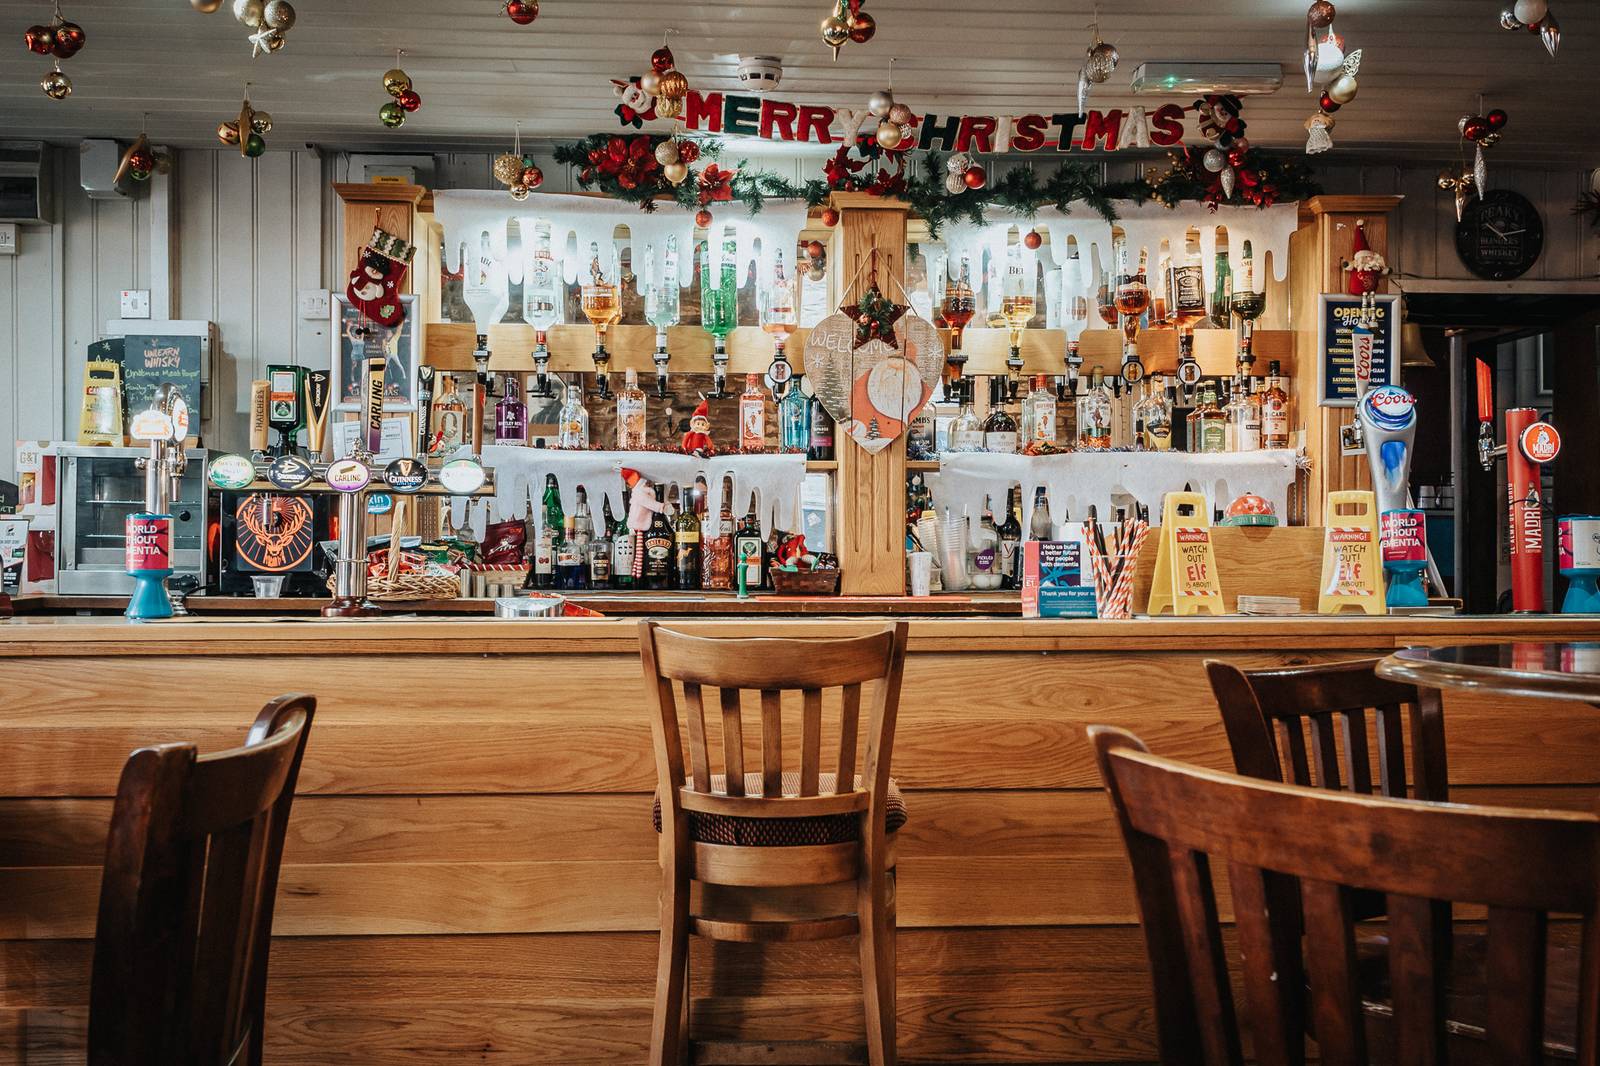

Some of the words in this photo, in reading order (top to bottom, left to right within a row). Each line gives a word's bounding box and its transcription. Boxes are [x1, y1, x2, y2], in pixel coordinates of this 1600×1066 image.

[686, 90, 869, 147] MERRY
[900, 104, 1185, 151] HRISTMAS
[144, 356, 180, 368] WHISKY
[1356, 337, 1370, 380] Coors
[369, 379, 383, 430] CARLING
[1372, 393, 1416, 407] Coors
[254, 390, 264, 433] THATCHERS
[334, 474, 361, 482] CARLING
[389, 475, 423, 483] GUINNESS
[1384, 518, 1417, 528] WORLD
[1521, 507, 1542, 549] MADRÍ
[1333, 533, 1367, 541] WARNING!
[1042, 544, 1056, 552] Help
[1382, 538, 1421, 548] EMENTIA
[1182, 545, 1208, 554] WATCH
[1333, 544, 1367, 553] WATCH
[1187, 554, 1204, 562] OUT!
[1340, 553, 1360, 561] OUT!
